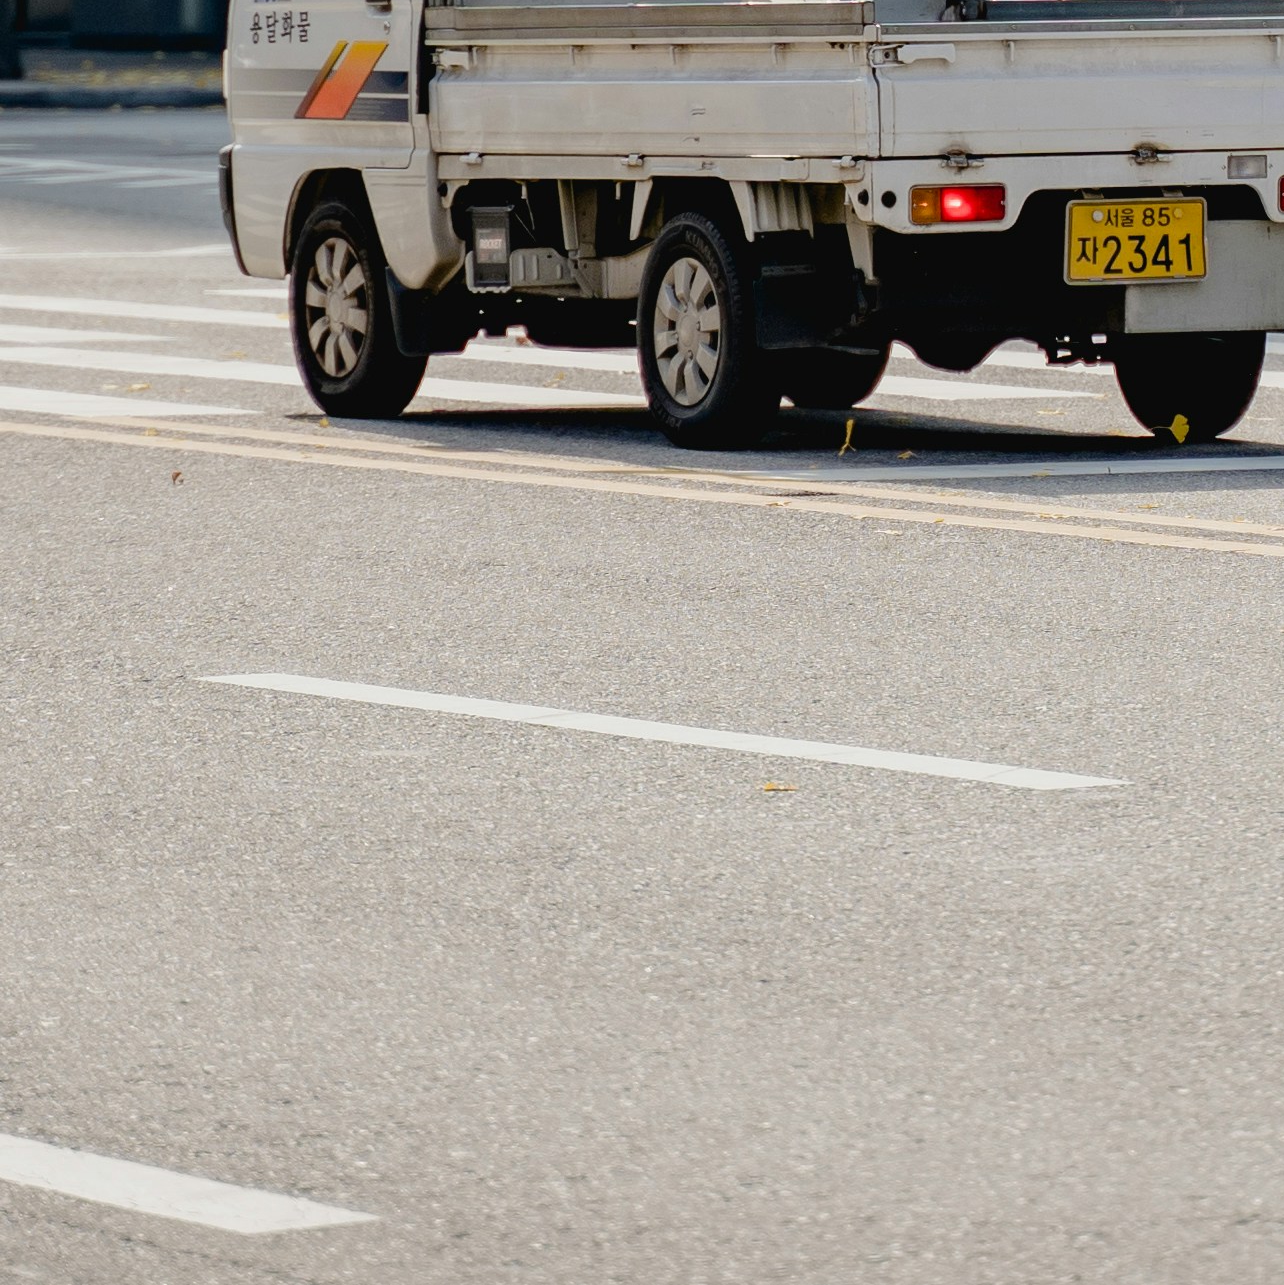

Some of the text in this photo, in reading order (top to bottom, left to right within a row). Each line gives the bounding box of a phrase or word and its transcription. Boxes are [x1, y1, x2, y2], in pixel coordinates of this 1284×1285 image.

[250, 10, 311, 44] 용달화물
[1104, 206, 1171, 228] 서울 85
[1076, 232, 1193, 275] 자 2341
